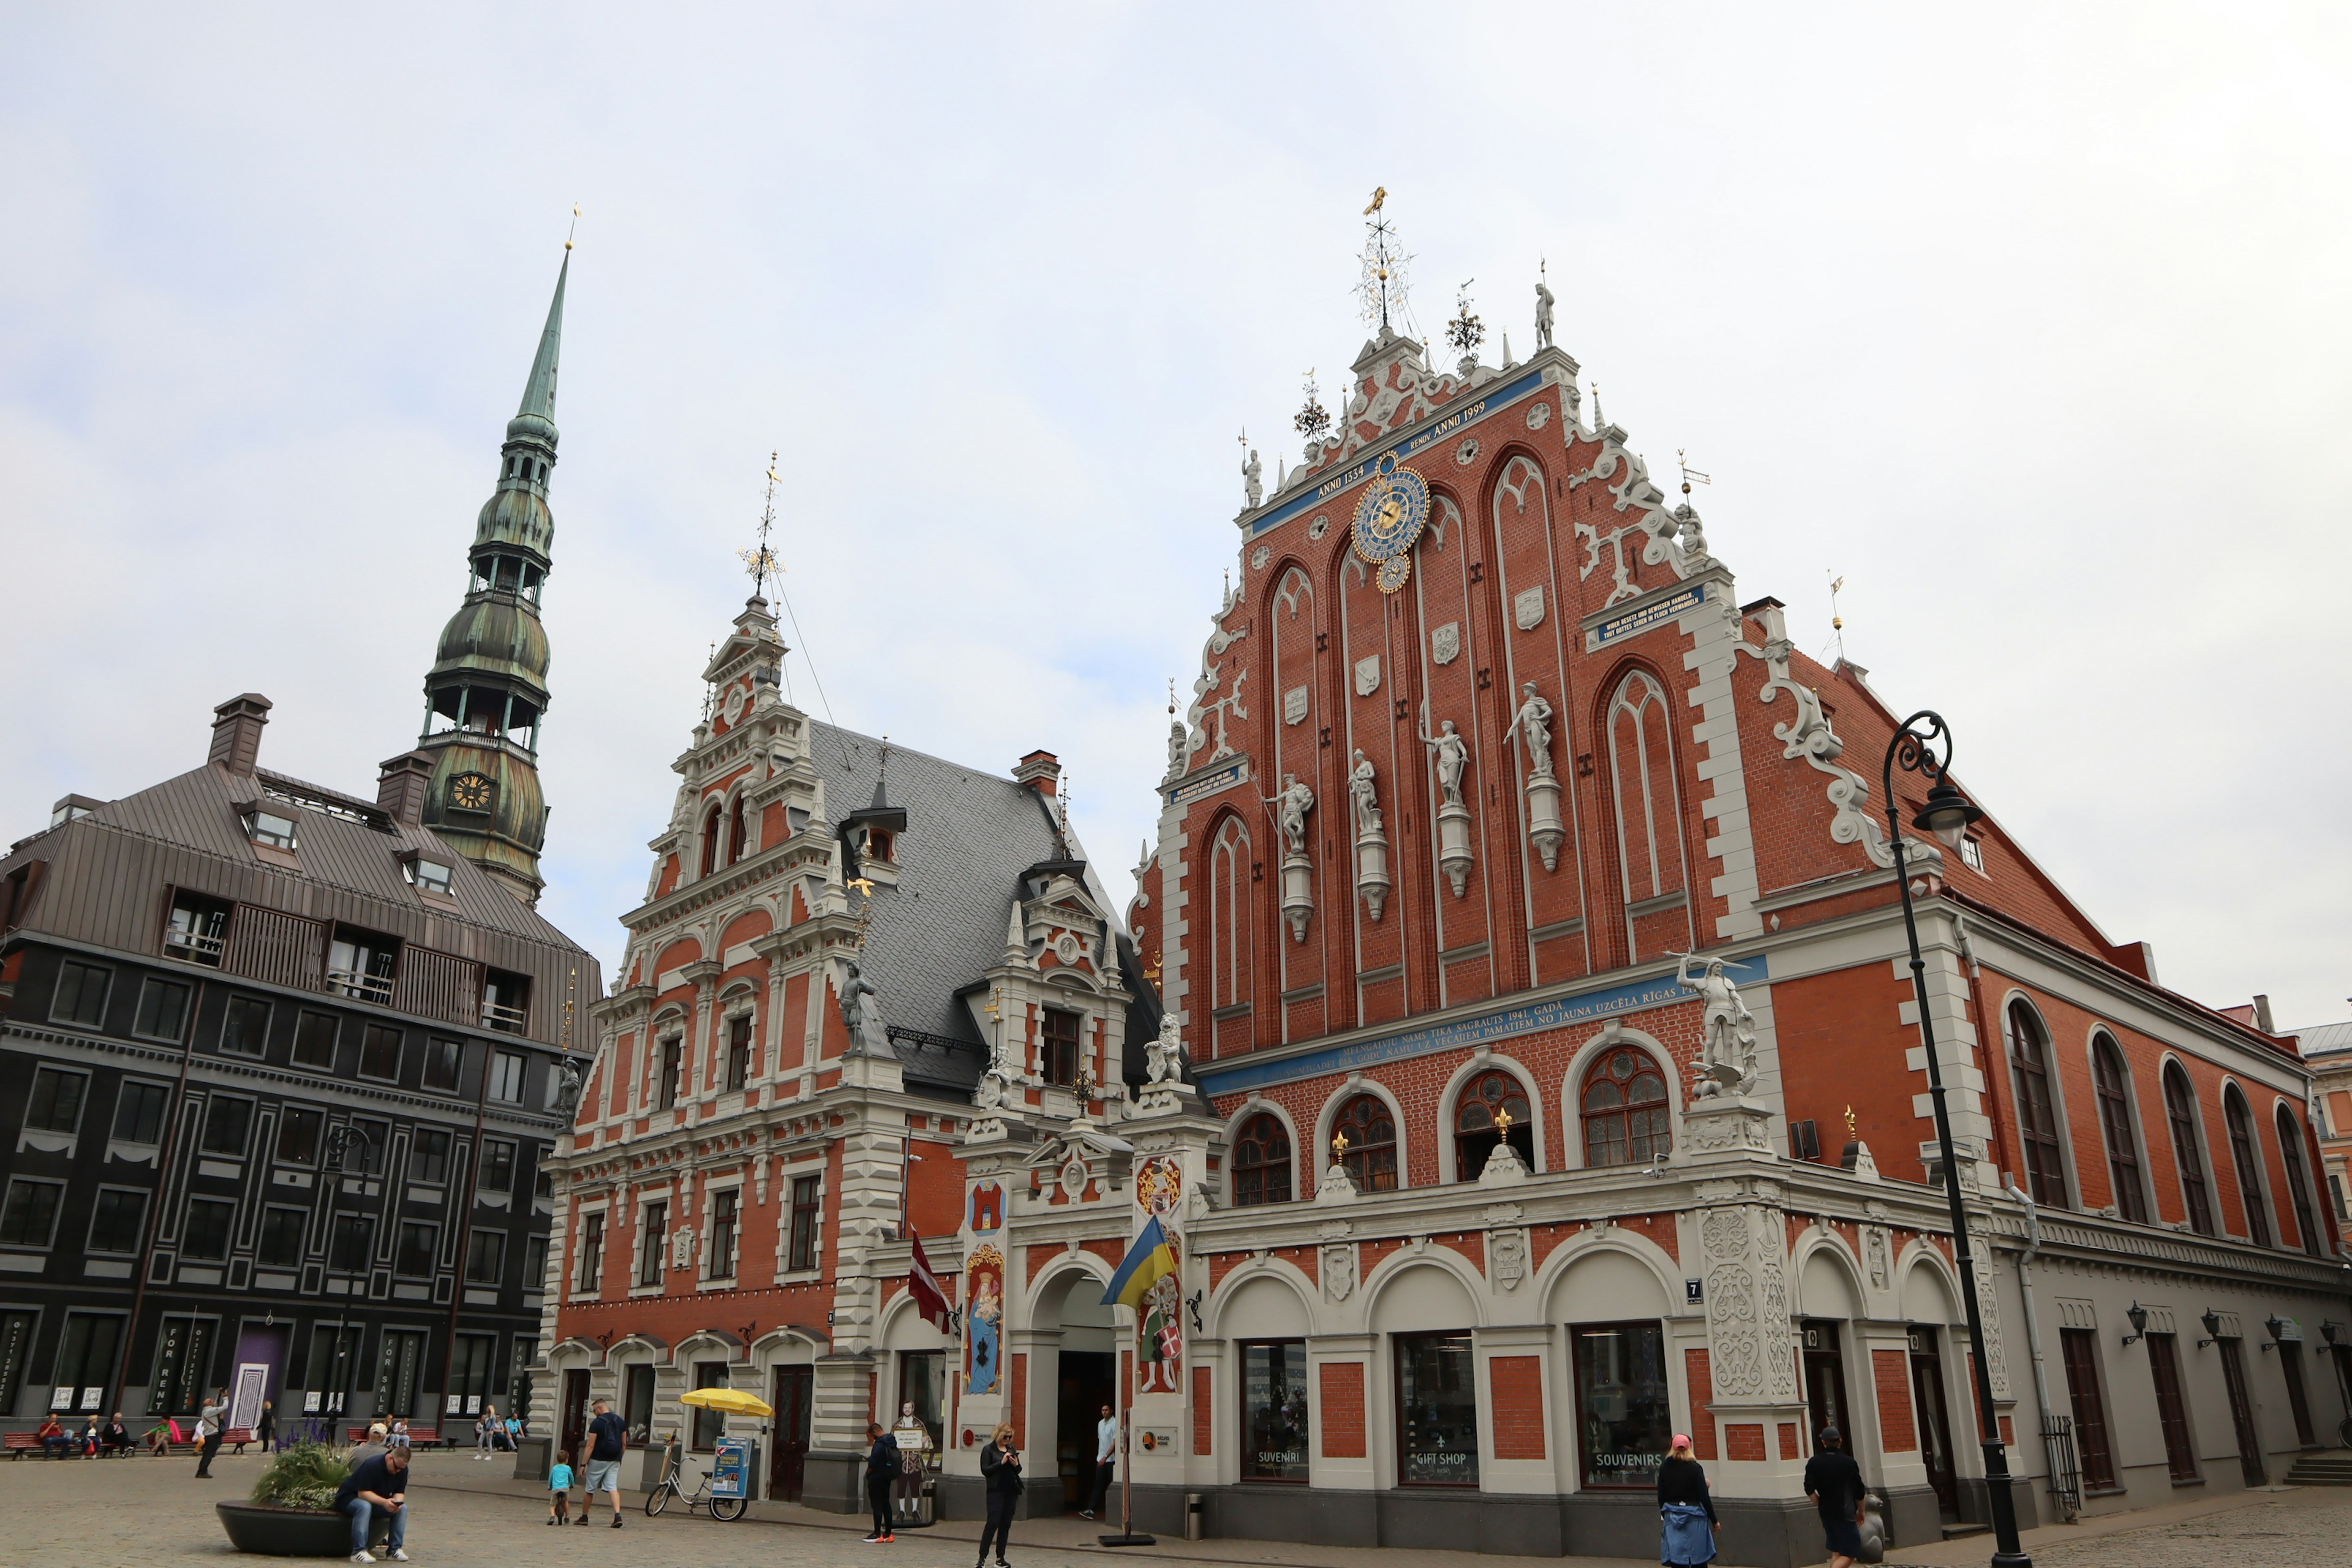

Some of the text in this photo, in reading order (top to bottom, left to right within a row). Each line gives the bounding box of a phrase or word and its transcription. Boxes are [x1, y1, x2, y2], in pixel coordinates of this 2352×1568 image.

[1318, 401, 1485, 499] ANNO 1334 RENOV. ANNO 1999
[1621, 614, 1637, 624] GESETZ
[1648, 600, 1670, 614] GEWISSEN
[1339, 1057, 1352, 1066] PAR
[1357, 1050, 1382, 1062] GODU
[1387, 1043, 1413, 1056] NAMU
[1418, 1040, 1431, 1050] UZ
[1436, 1030, 1480, 1046] VECAJIEM
[1485, 1019, 1533, 1036] PAMATIEM
[1538, 1014, 1554, 1025] NO
[1559, 1005, 1591, 1022] JAUNA
[1596, 996, 1637, 1011] UZCĒLA
[1643, 987, 1676, 1003] RĪGAS
[1343, 1001, 1566, 1055] MELNGALVJU NAMS TIKA SAGRAUTS 1941. GADĀ.
[1691, 1285, 1696, 1295] 7
[165, 1329, 176, 1358] FOR
[385, 1339, 393, 1366] FOR
[156, 1369, 168, 1410] RENT
[378, 1376, 387, 1412] SALE
[1259, 1450, 1299, 1463] SUVENĪRI
[1417, 1453, 1466, 1464] GIFT SHOP
[1596, 1454, 1662, 1466] SOUVENIRS
